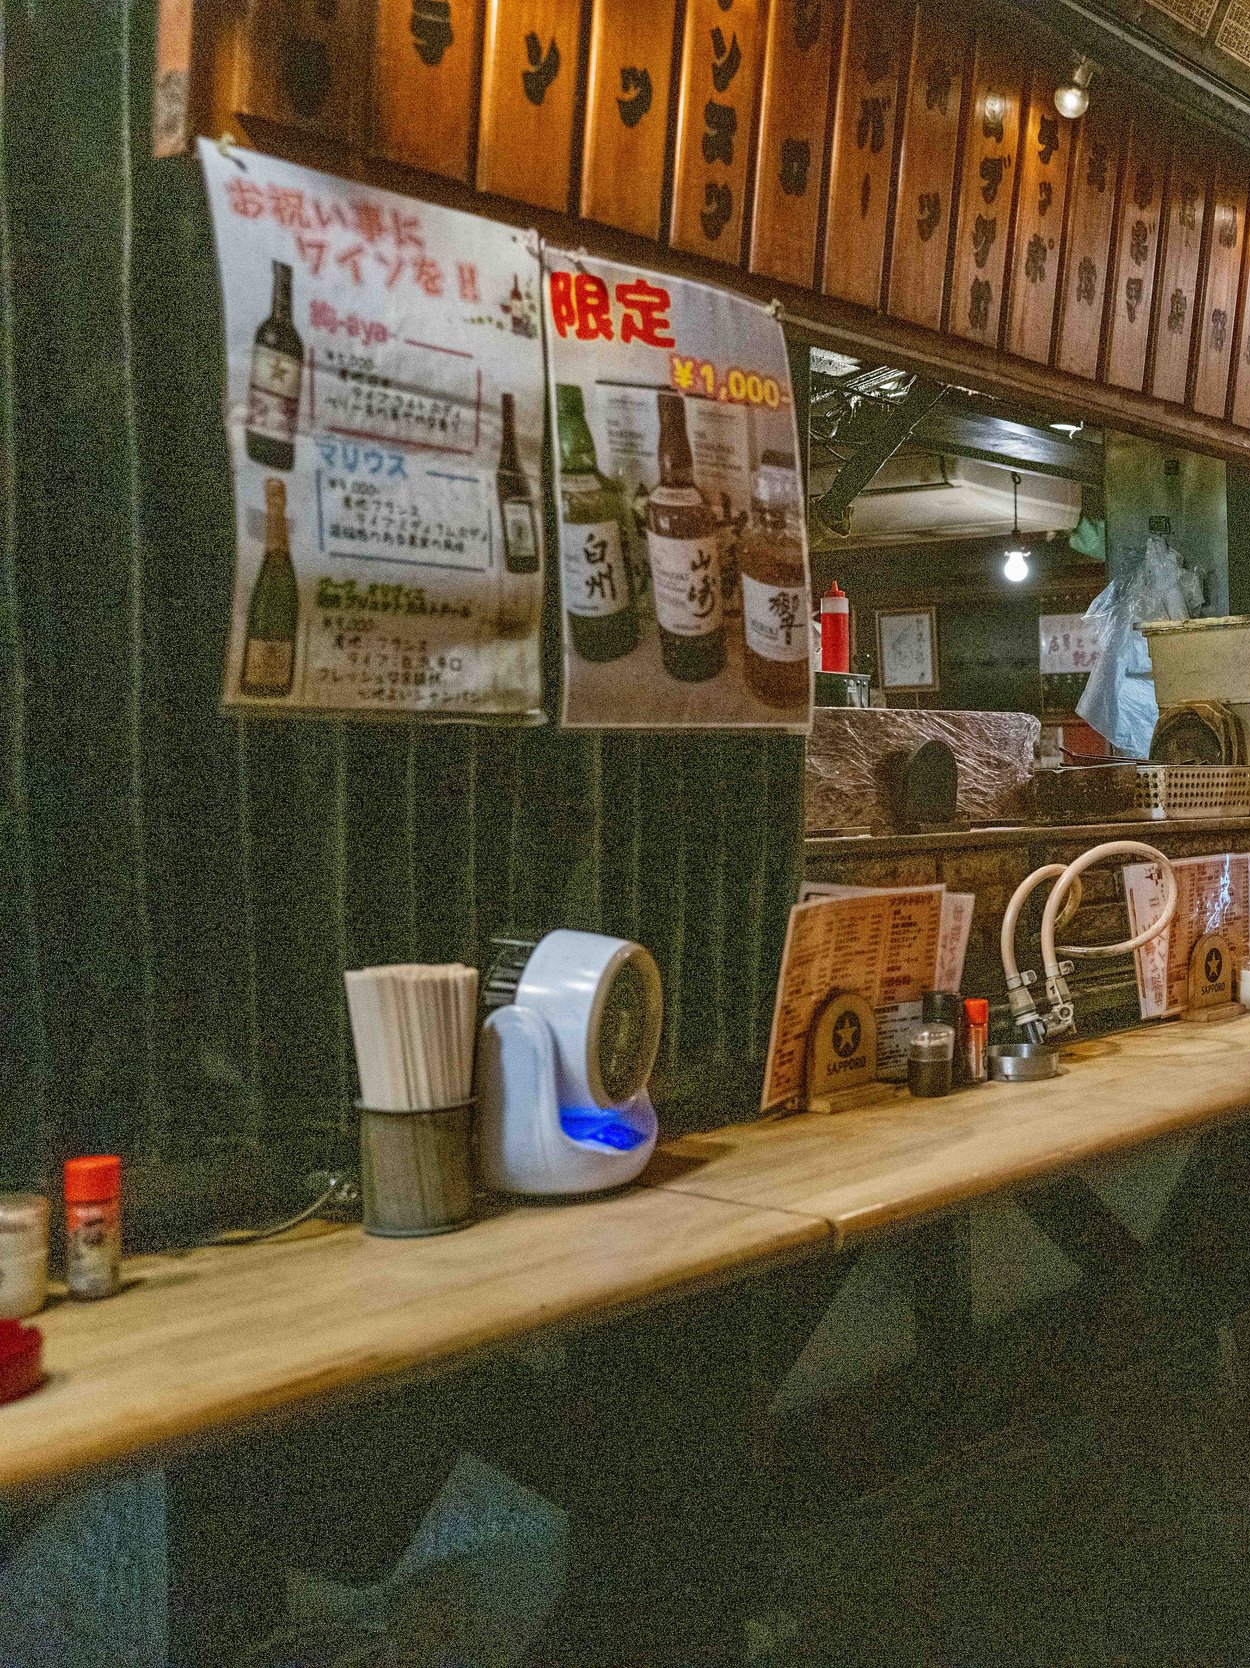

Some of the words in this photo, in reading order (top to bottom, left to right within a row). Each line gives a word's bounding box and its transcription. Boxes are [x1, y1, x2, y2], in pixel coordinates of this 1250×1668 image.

[226, 176, 426, 248] お祝い事に
[549, 271, 676, 349] 限定
[317, 442, 409, 480] マリウス
[581, 531, 618, 602] 白州
[687, 548, 717, 619] 山崎
[767, 590, 806, 646] 響
[1200, 981, 1226, 996] SAPPORO
[826, 1055, 867, 1075] SAPPORO
